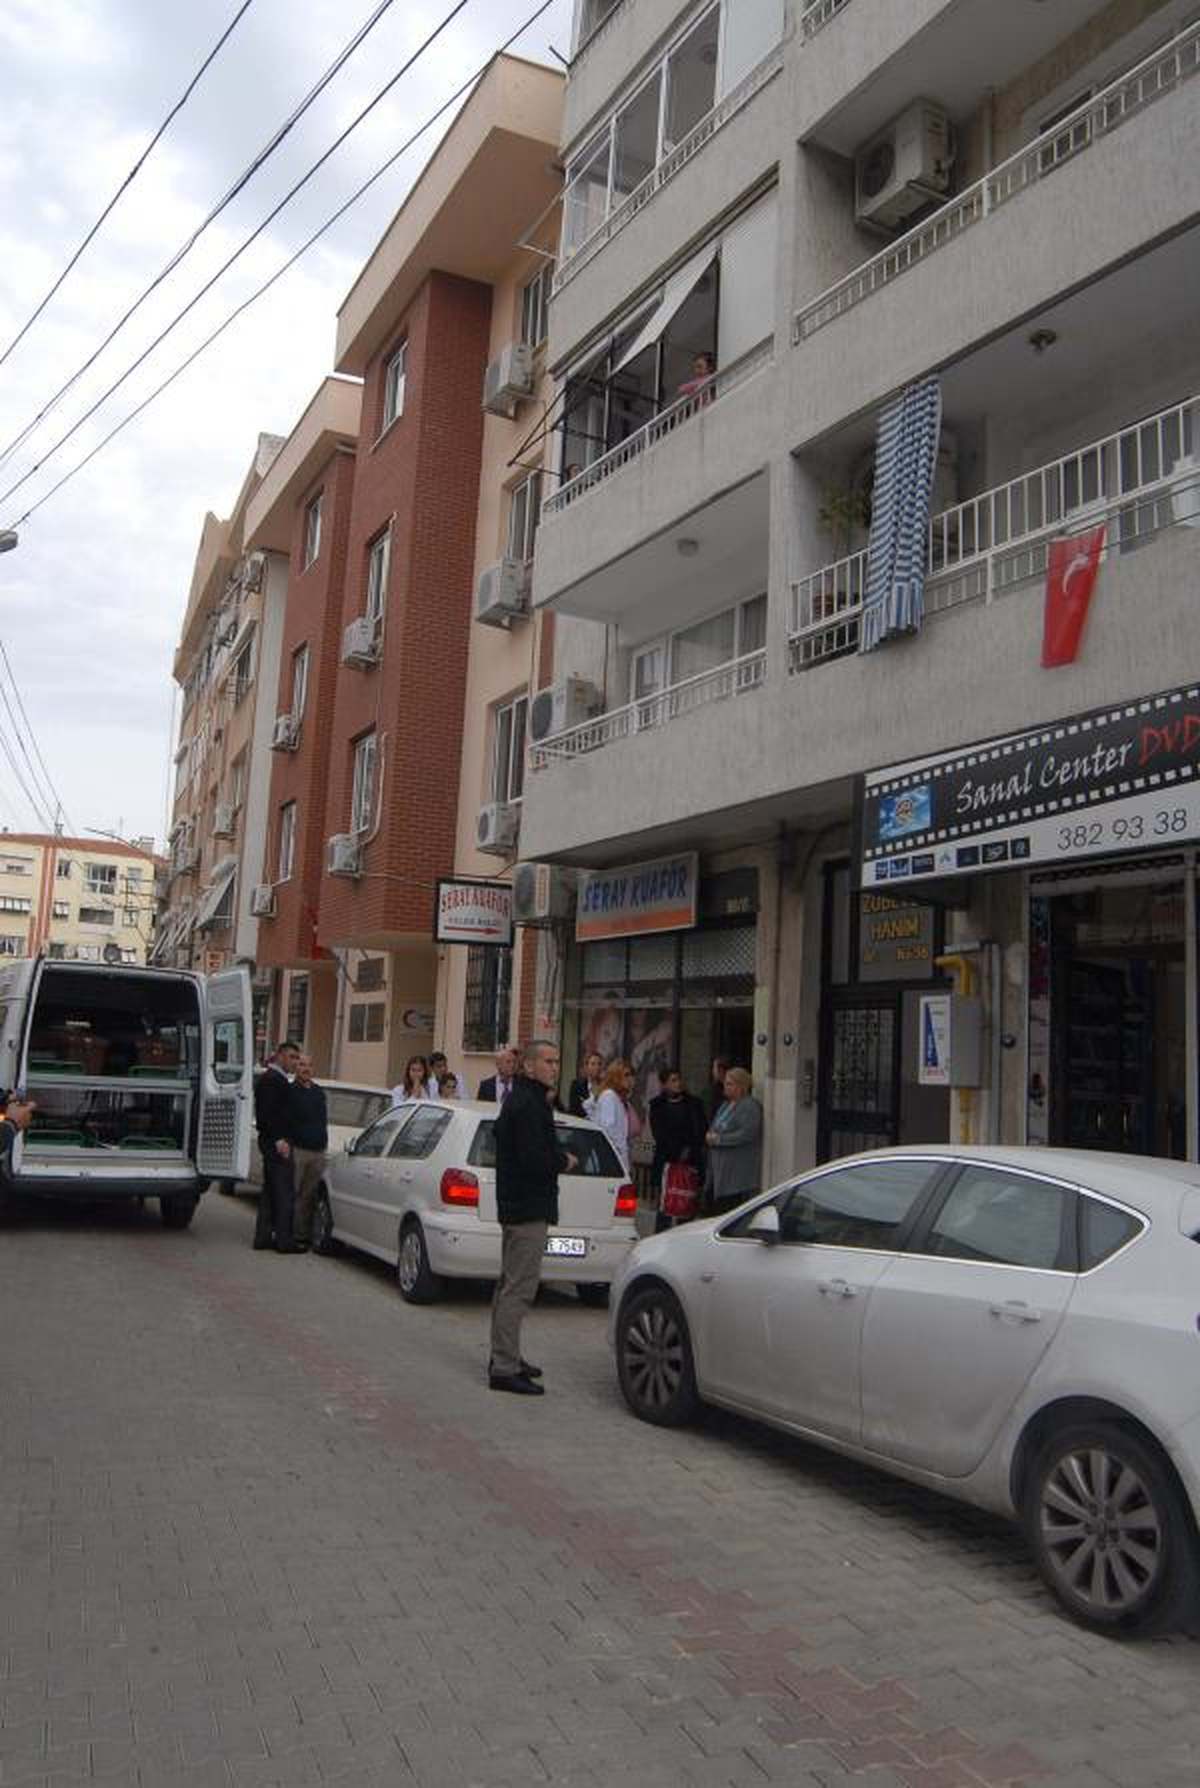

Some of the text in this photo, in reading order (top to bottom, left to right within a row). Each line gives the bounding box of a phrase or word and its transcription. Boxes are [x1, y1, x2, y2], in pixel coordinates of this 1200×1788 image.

[956, 714, 1200, 814] Sanal Center DVD
[1057, 822, 1103, 851] 382
[1112, 815, 1144, 841] 93
[1153, 808, 1188, 835] 38
[582, 877, 627, 913] SERAY
